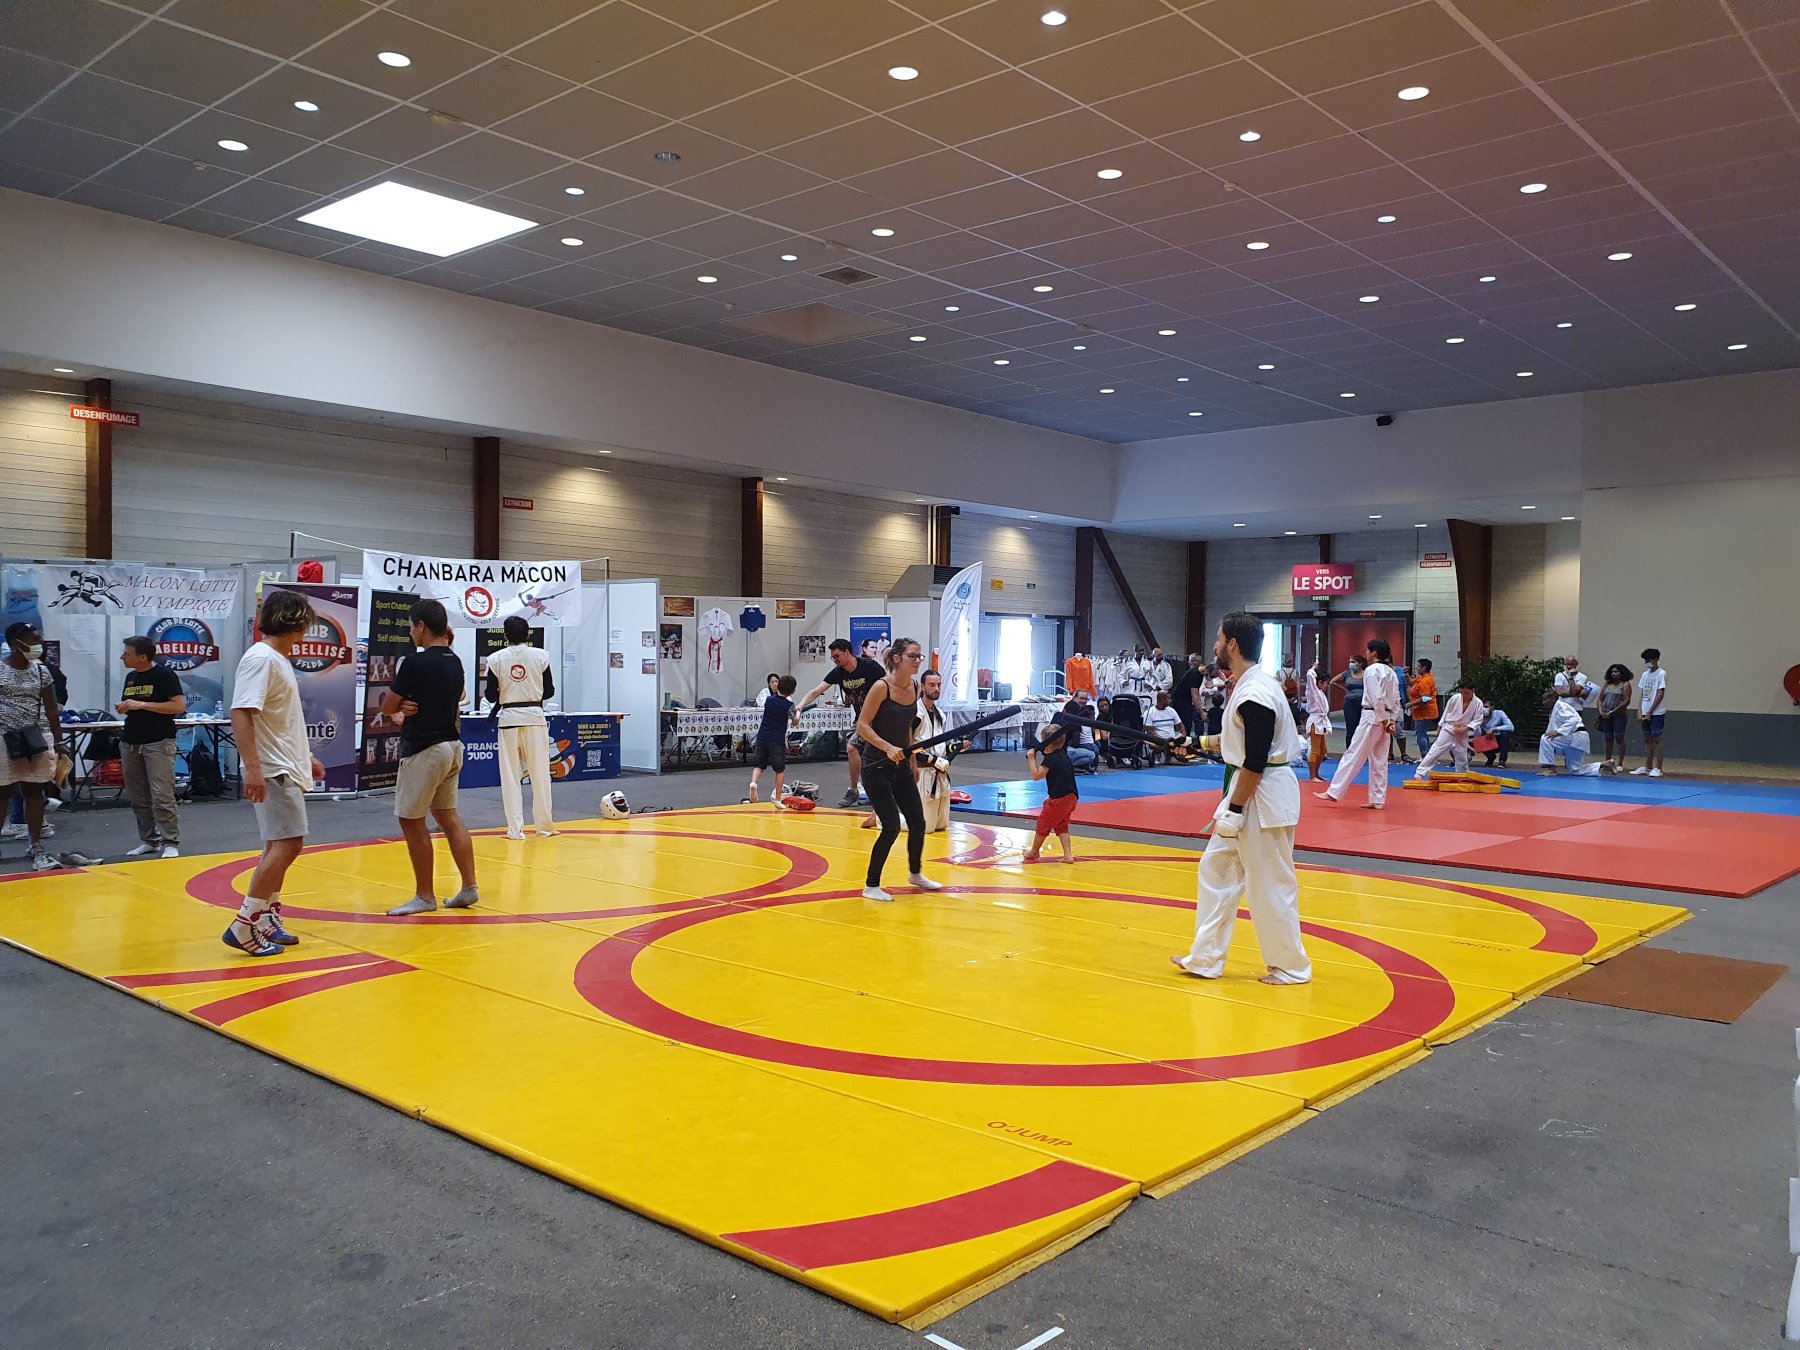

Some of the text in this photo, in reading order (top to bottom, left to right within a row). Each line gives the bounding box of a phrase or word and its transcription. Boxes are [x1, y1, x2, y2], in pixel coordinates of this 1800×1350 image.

[73, 408, 137, 424] DESENFUMAGE
[384, 557, 566, 583] CHANBARA MÂCON
[1294, 576, 1352, 590] LE SPOT
[131, 595, 231, 613] OLYMPIQUE
[155, 619, 173, 633] CLUB
[184, 618, 206, 634] LUTTE
[155, 643, 214, 656] ABELLISÉ
[288, 643, 346, 659] BELLISÉ
[165, 660, 195, 670] FFLDA
[296, 659, 324, 669] FFLDA
[306, 721, 335, 738] nté
[467, 742, 499, 751] FRANC
[467, 752, 493, 761] JUDO
[986, 1121, 1073, 1146] O'JUMP
